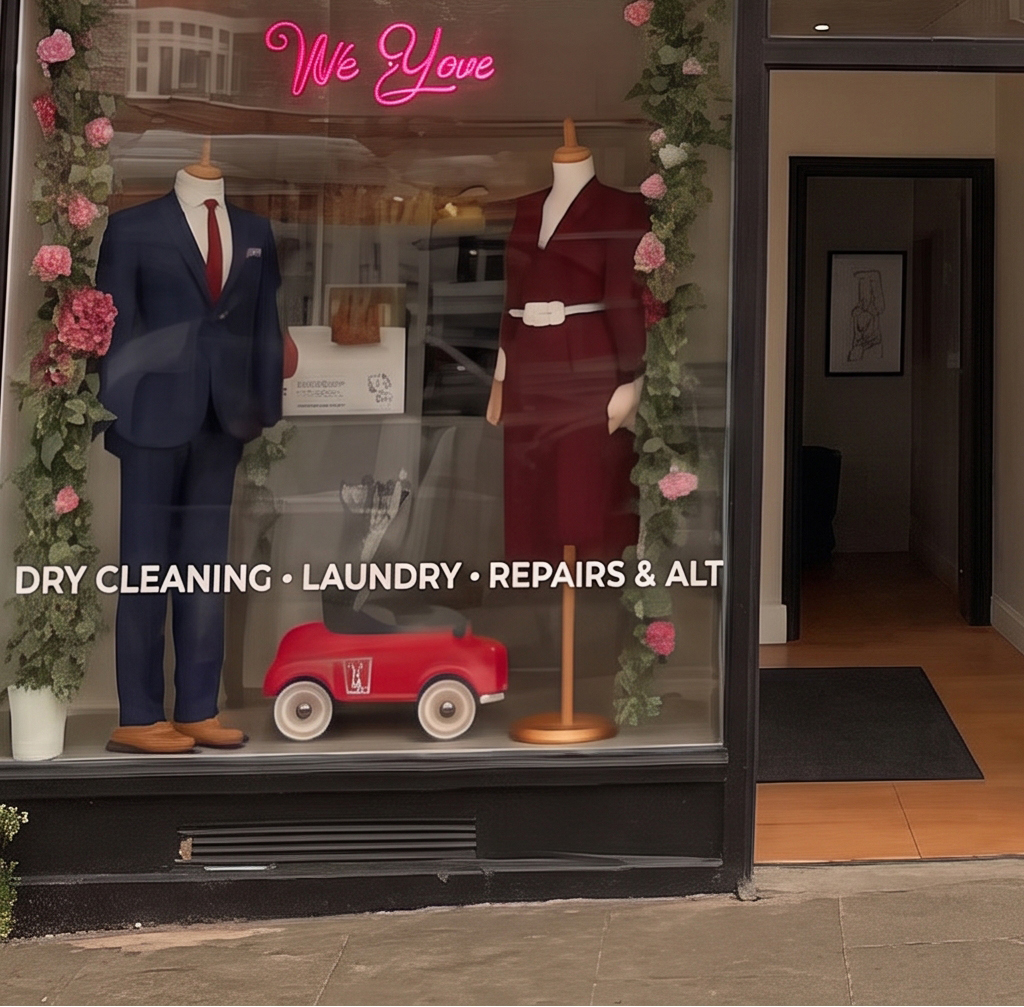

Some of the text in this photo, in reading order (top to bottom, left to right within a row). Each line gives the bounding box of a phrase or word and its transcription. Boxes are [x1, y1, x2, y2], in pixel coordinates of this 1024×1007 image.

[265, 21, 360, 96] We
[15, 559, 724, 595] DRY CLEANING LAUNDRY REPAIRS & ALT
